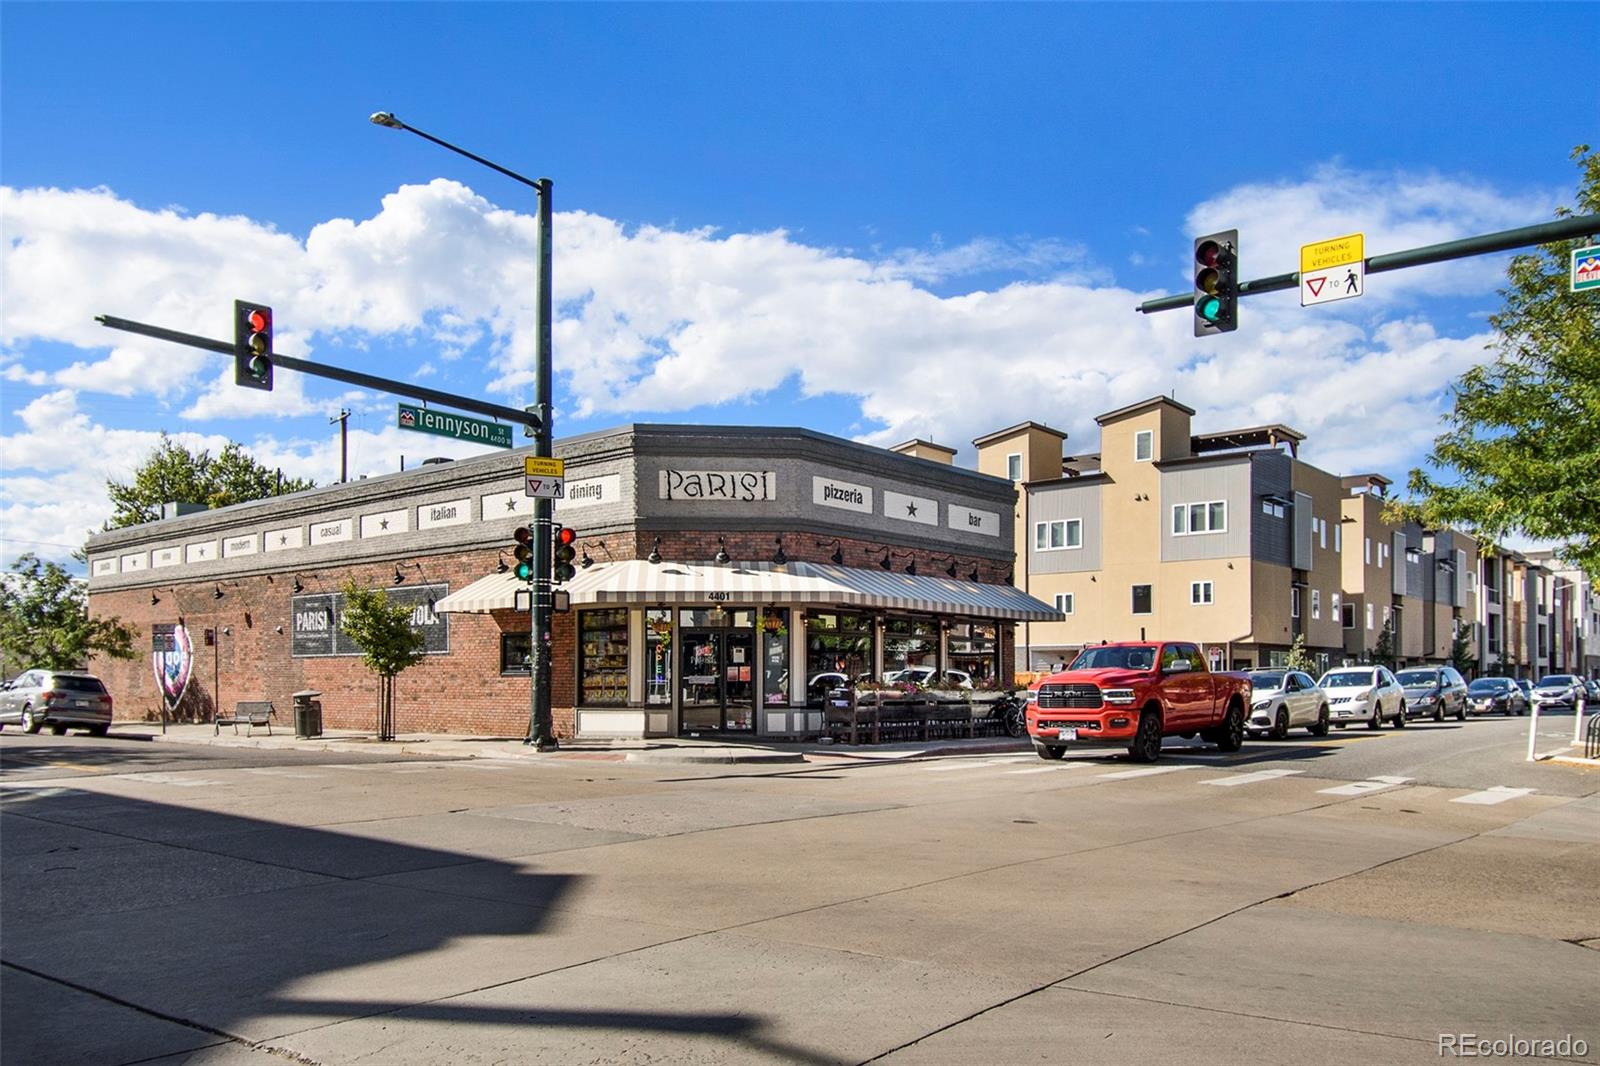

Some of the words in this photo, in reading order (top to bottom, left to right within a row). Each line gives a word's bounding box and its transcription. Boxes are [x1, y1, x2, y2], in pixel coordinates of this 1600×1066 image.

[1314, 241, 1350, 255] TURNING
[1312, 253, 1352, 267] VEHICLES
[1329, 280, 1340, 288] TO
[417, 409, 489, 438] Tennyson
[497, 426, 505, 436] St
[490, 434, 506, 444] 4400
[569, 483, 602, 500] dining
[823, 483, 864, 505] pizzeria
[430, 506, 457, 521] italian
[968, 512, 982, 528] bar
[320, 523, 342, 538] casual
[230, 540, 250, 551] modern
[708, 592, 731, 601] 4401
[296, 611, 328, 631] PARISI
